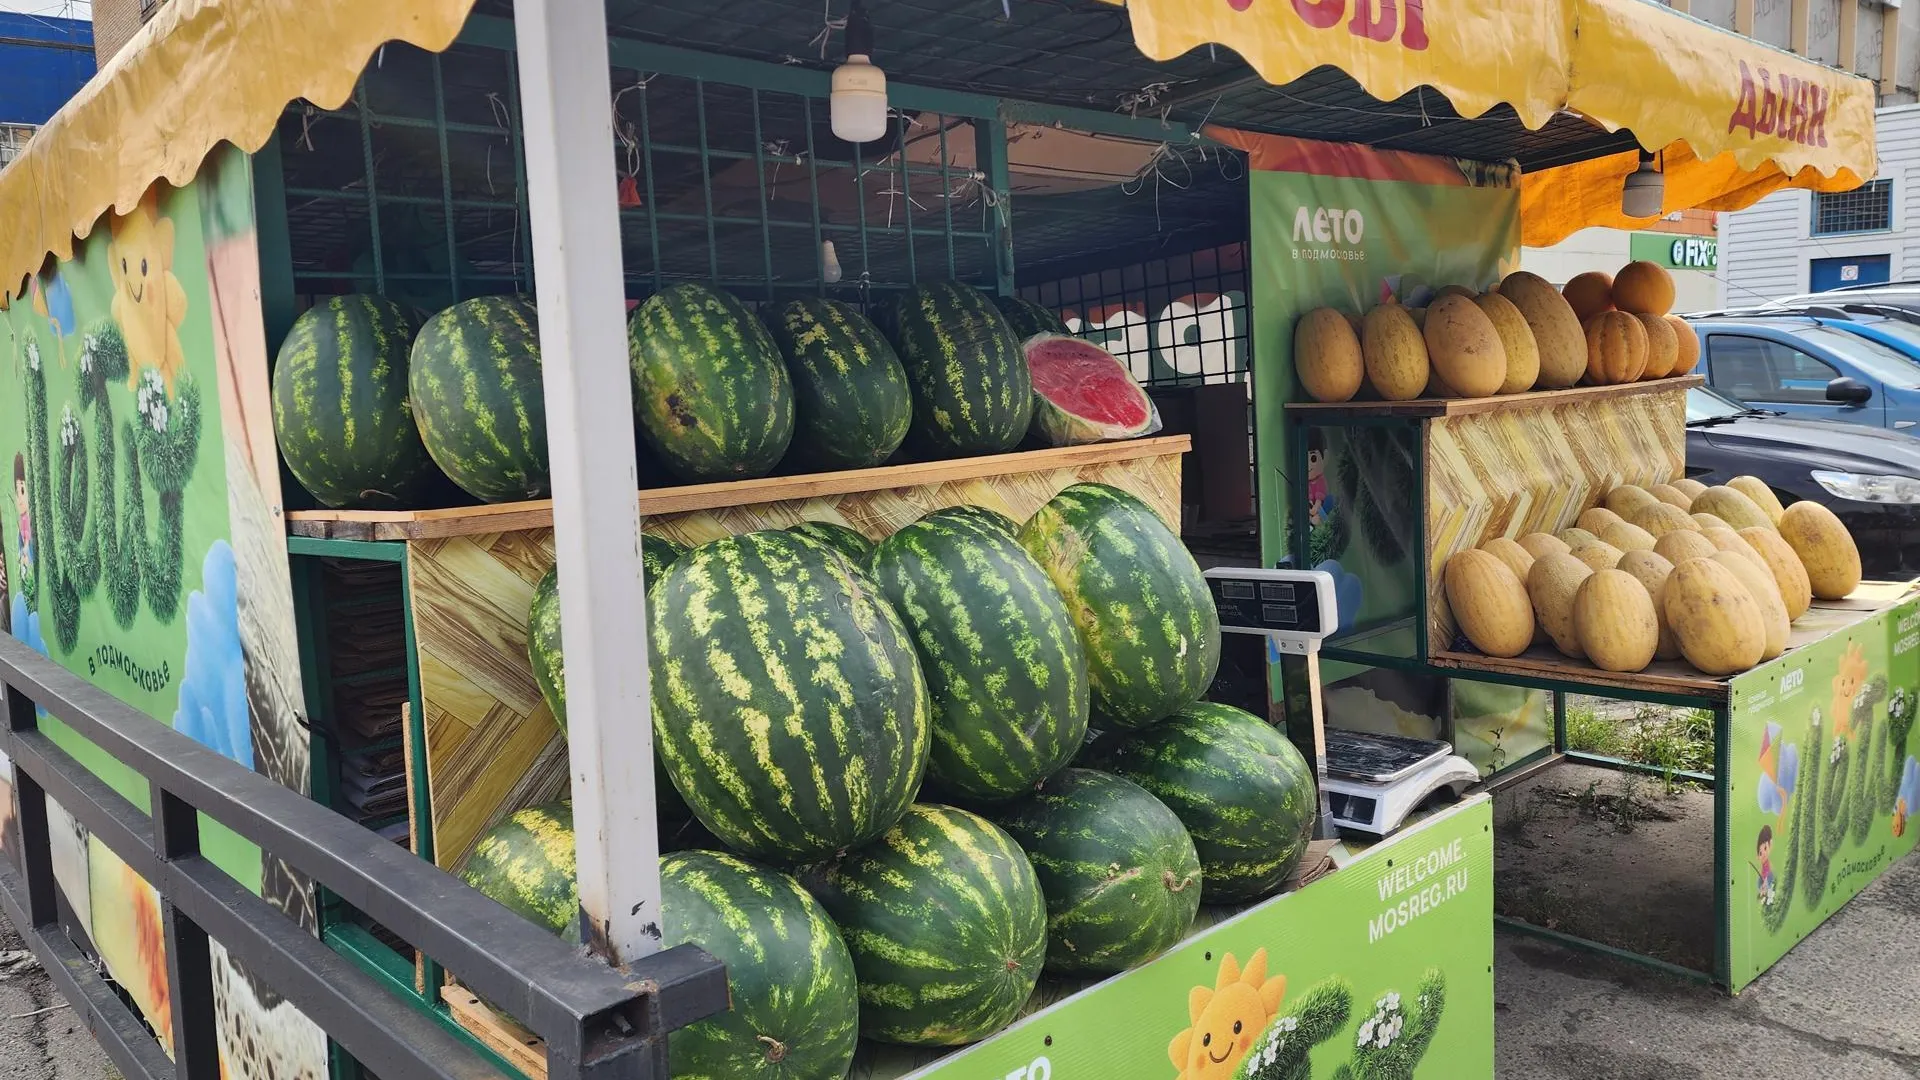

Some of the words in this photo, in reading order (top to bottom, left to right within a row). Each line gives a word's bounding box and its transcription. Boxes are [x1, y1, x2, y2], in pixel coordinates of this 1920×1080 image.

[1728, 59, 1828, 148] ДЫНИ
[1369, 867, 1469, 944] MOSREG.RU
[1378, 837, 1467, 902] WELCOME.
